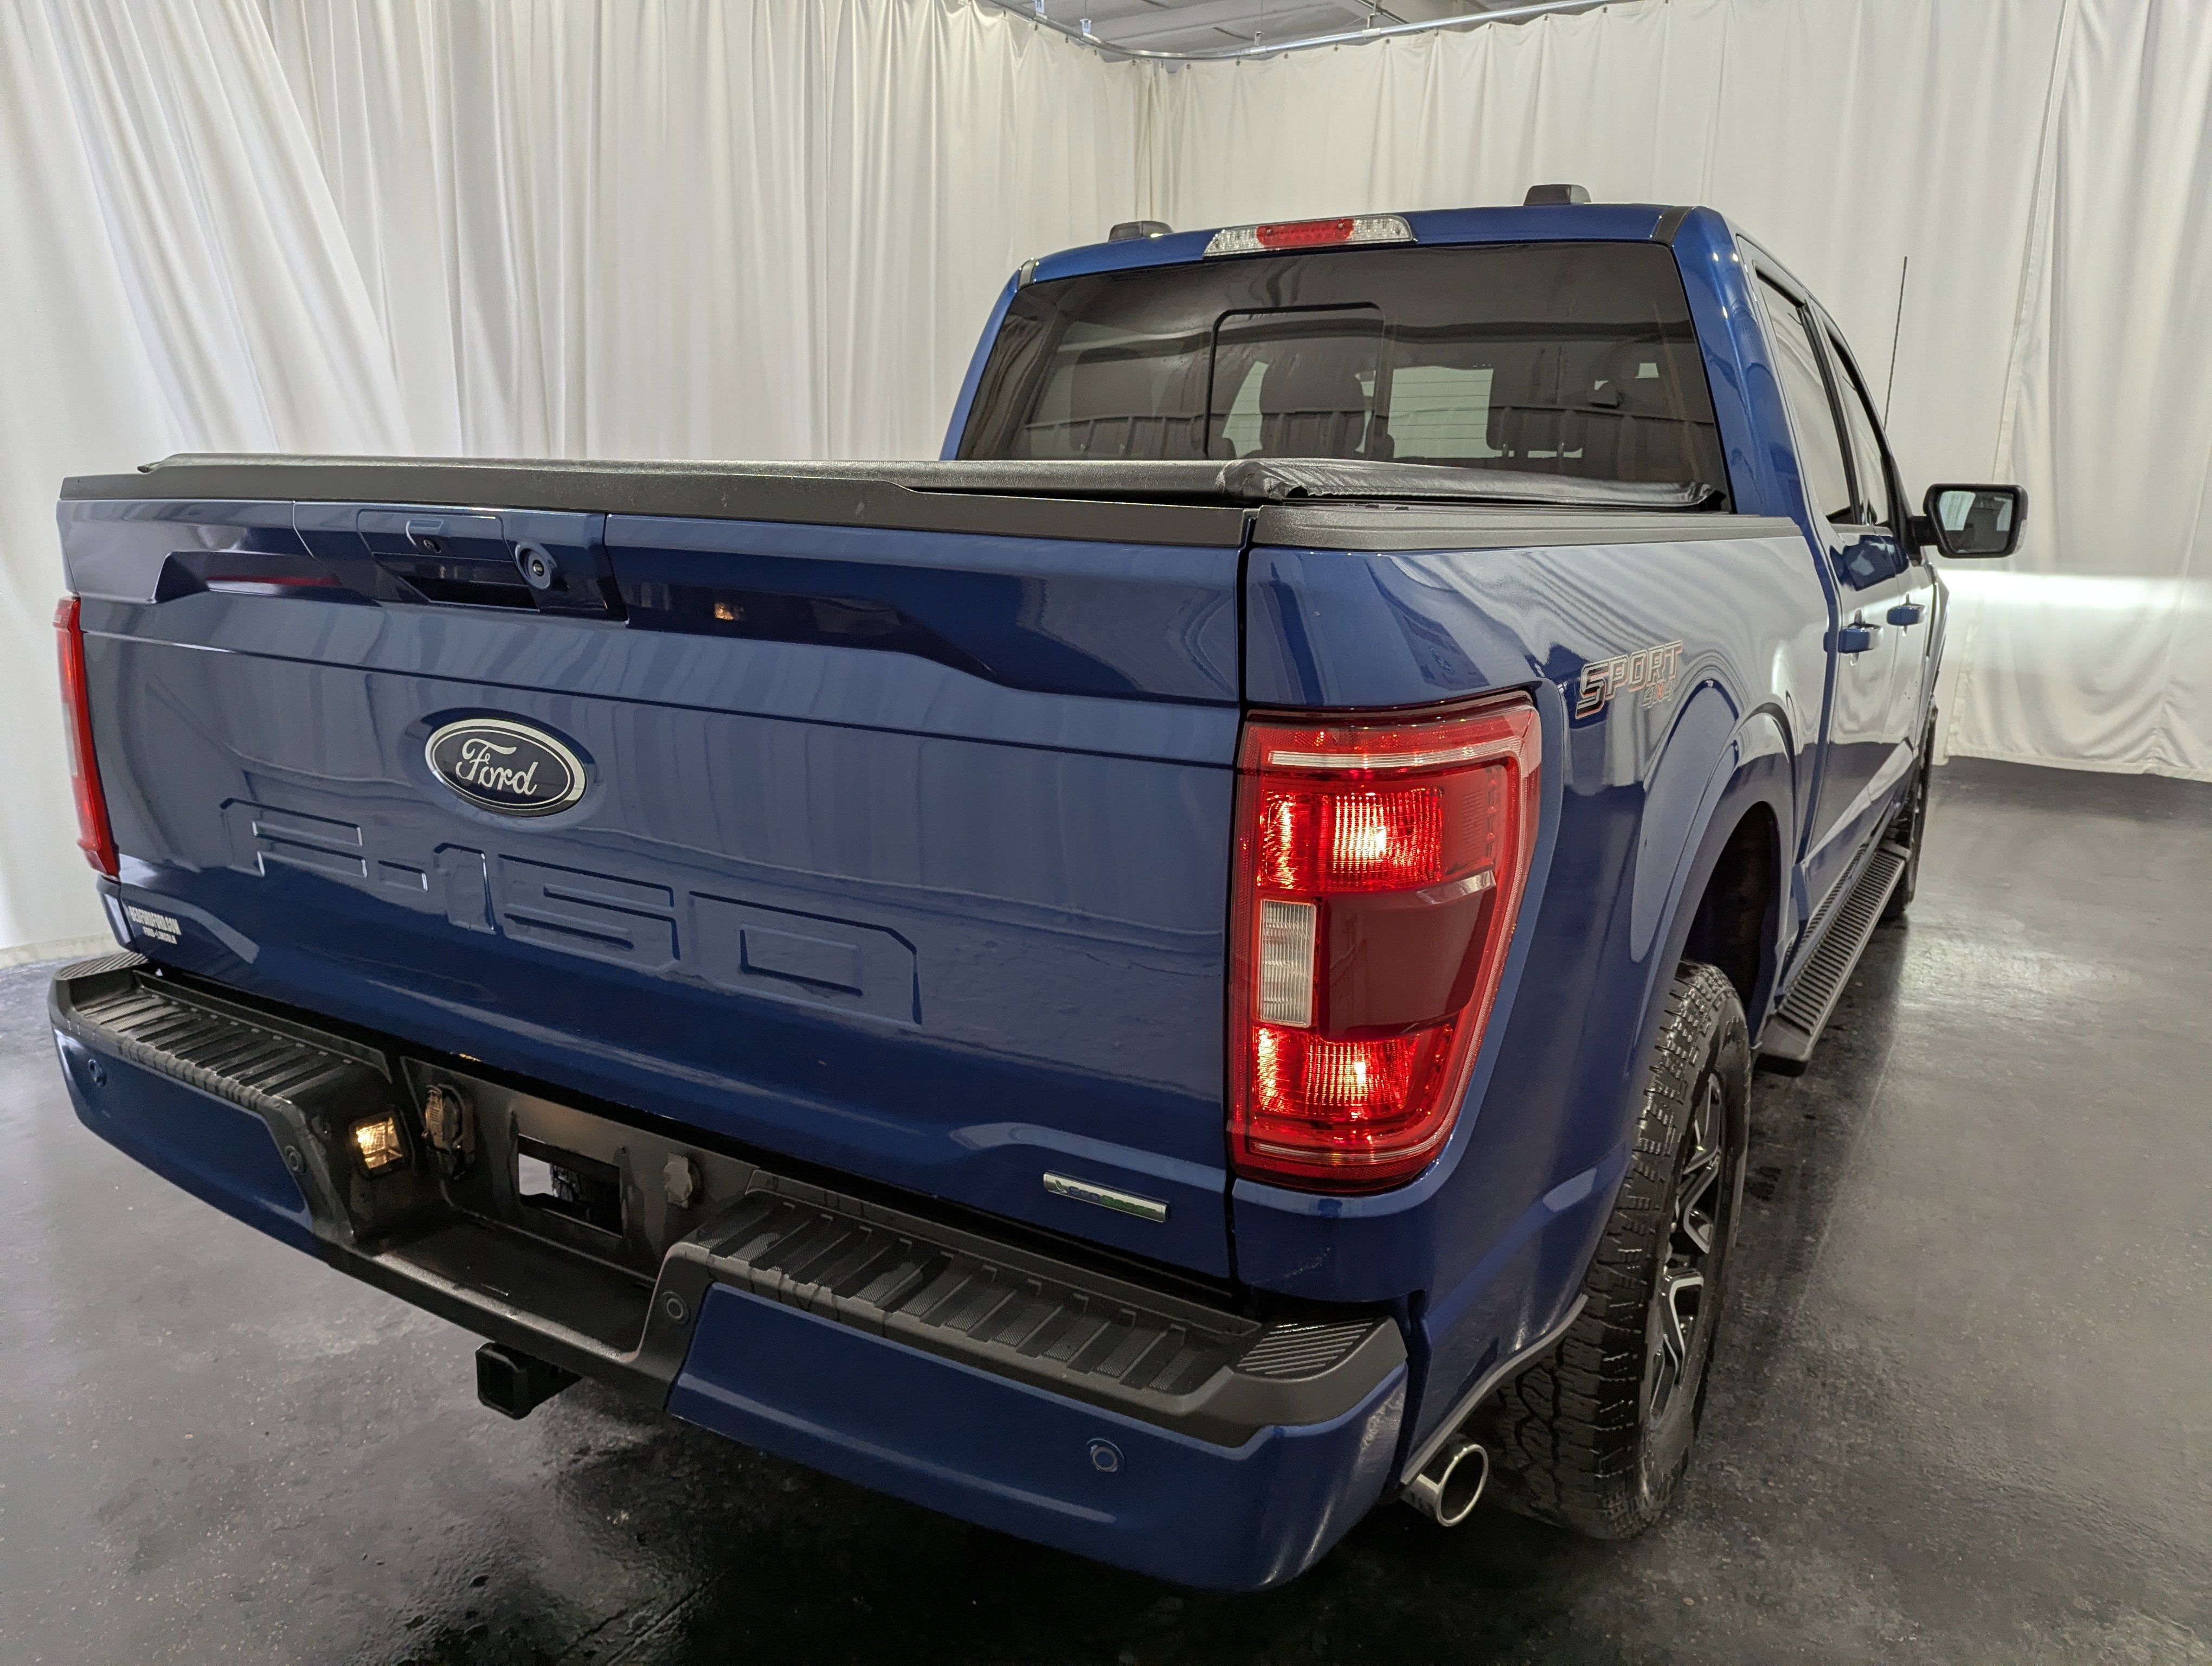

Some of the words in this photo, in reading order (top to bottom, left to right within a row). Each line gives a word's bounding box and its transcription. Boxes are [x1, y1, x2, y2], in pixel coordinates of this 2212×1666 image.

[1575, 640, 1682, 719] SPORT
[455, 738, 538, 796] Ford
[219, 797, 922, 1028] F-150
